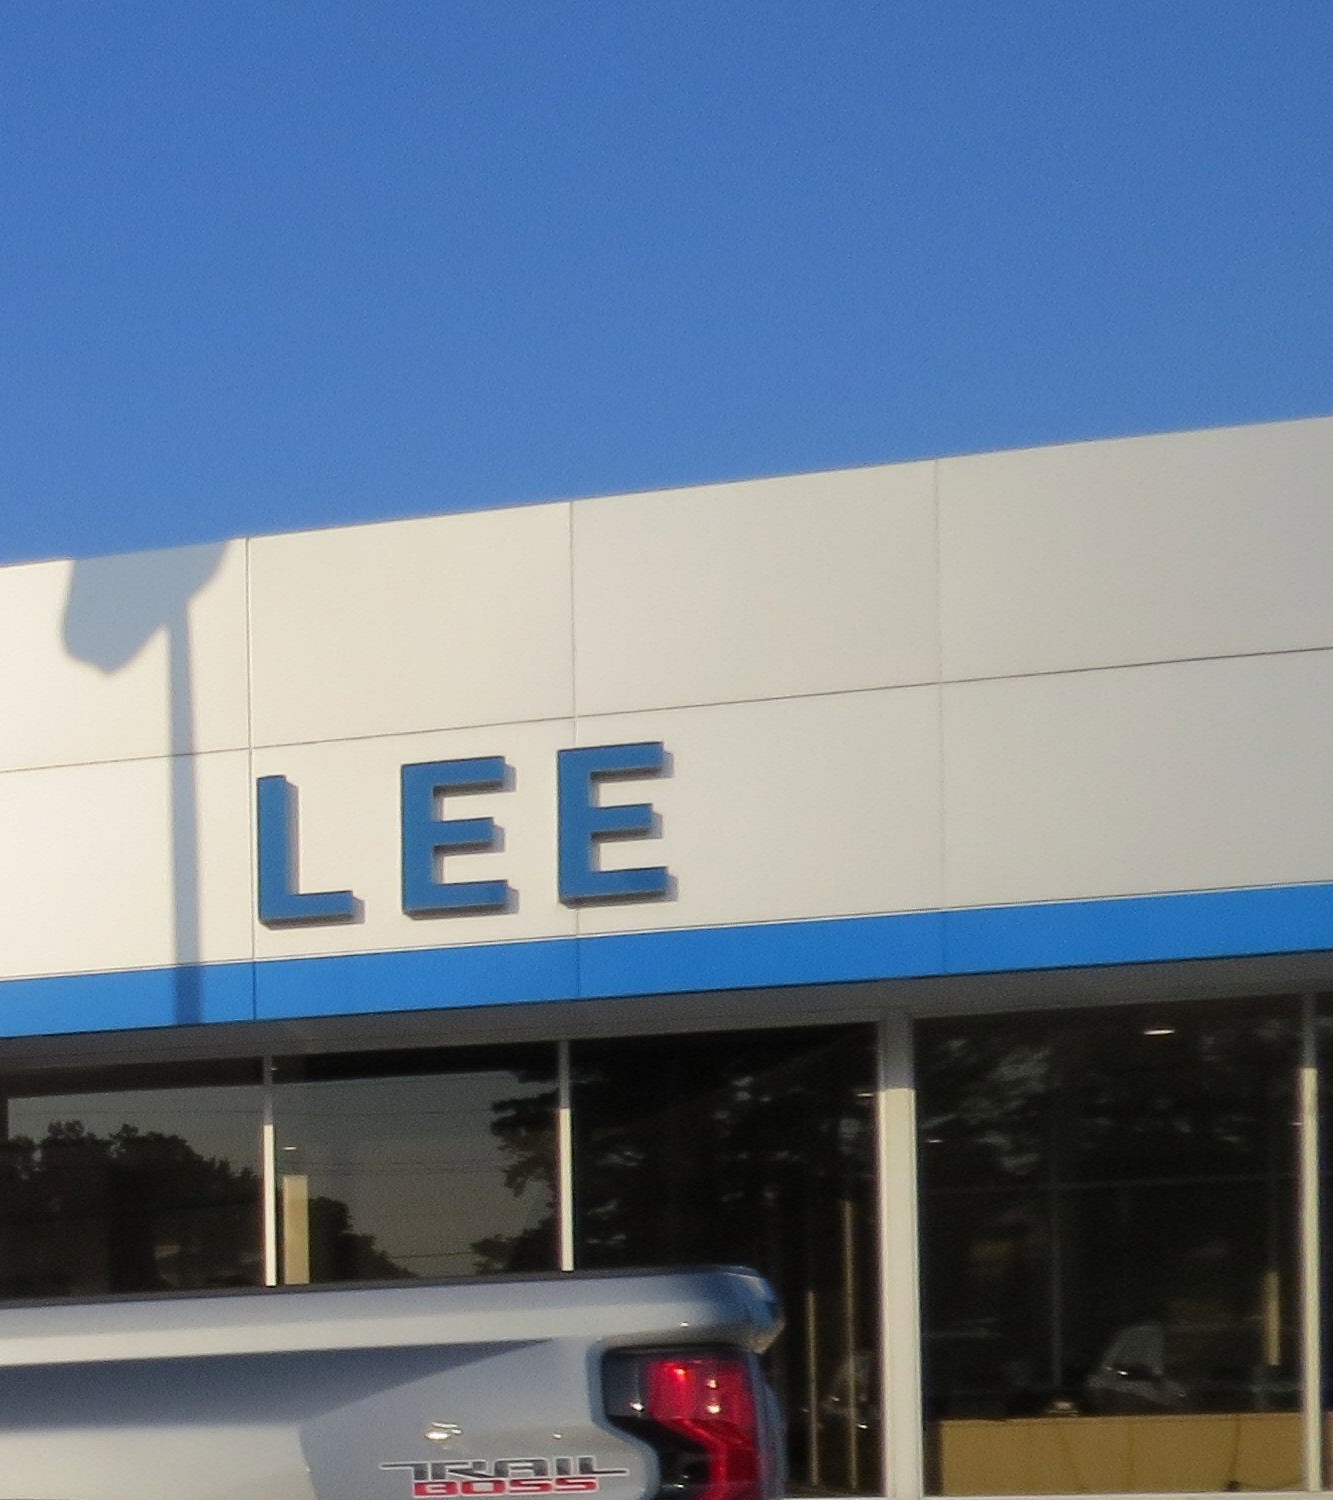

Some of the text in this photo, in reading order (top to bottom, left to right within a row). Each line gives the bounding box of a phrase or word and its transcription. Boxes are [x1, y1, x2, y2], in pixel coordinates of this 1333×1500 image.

[257, 741, 670, 927] LEE
[381, 1455, 629, 1481] TRAIL
[413, 1477, 599, 1498] BOSS
